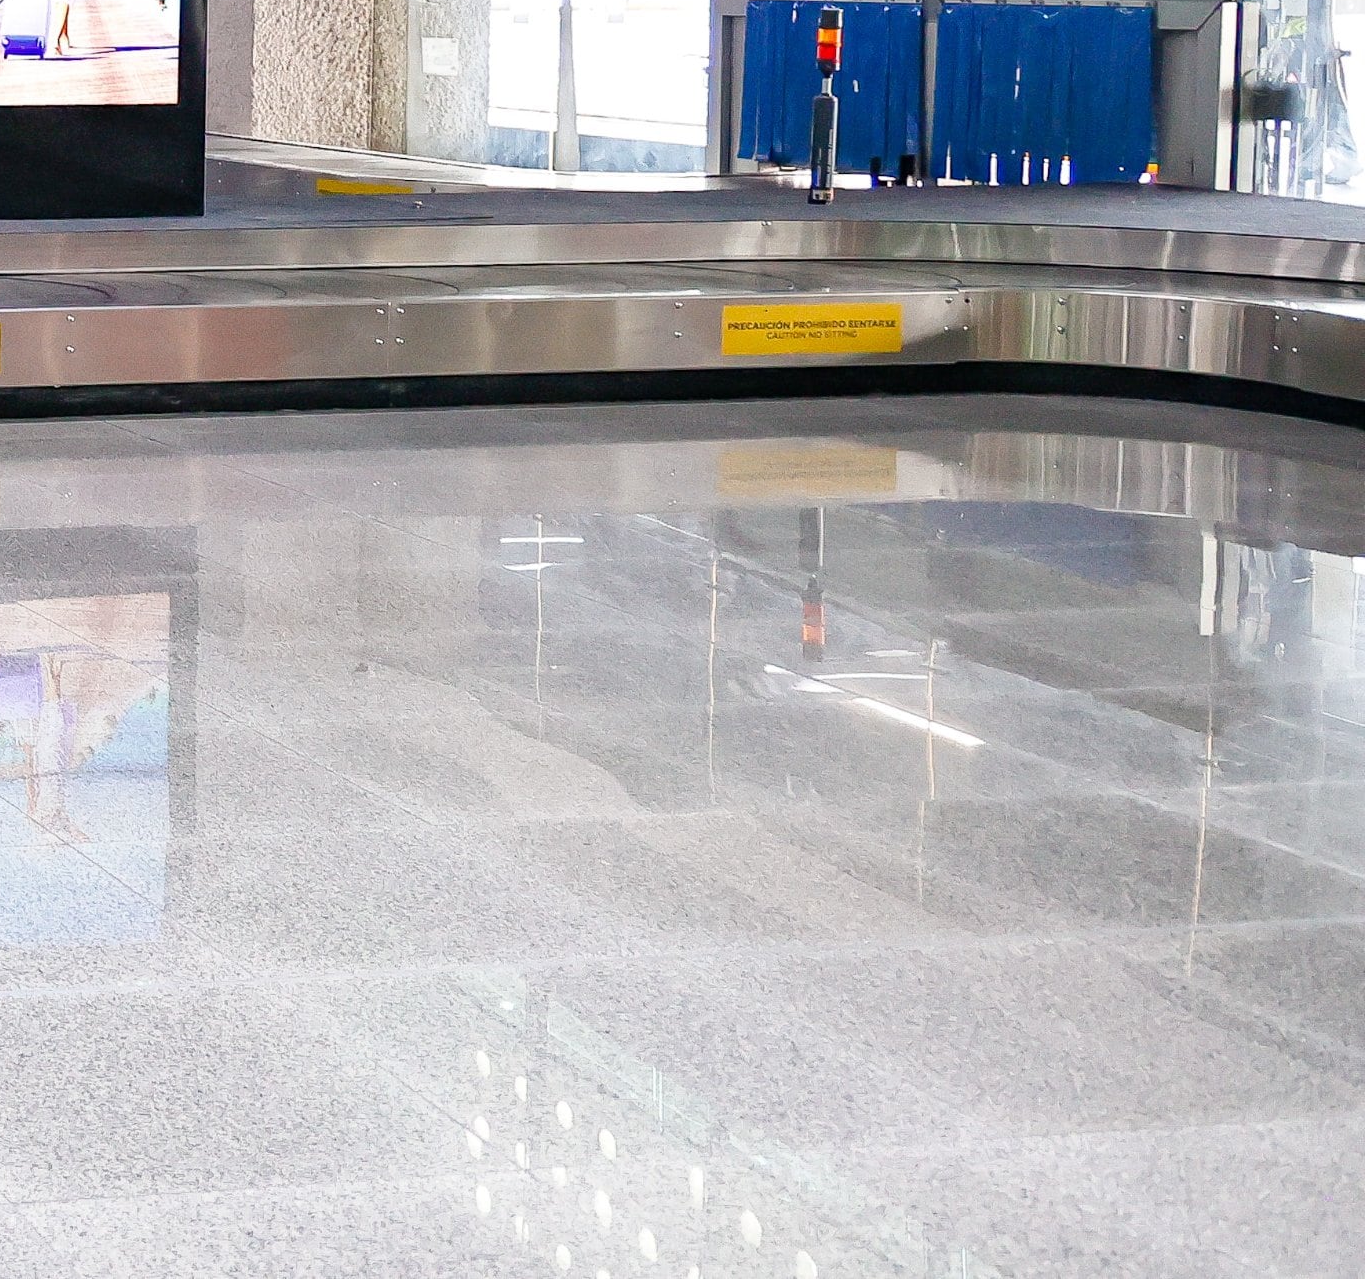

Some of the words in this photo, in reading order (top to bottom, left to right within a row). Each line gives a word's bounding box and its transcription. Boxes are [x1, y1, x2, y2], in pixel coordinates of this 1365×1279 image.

[727, 320, 790, 331] PRECAUCIÓN
[793, 320, 846, 329] PROHIBIDO
[848, 320, 896, 328] SENTARSE
[766, 331, 806, 340] CAUTION
[808, 331, 823, 339] NO
[824, 330, 858, 338] SITTING
